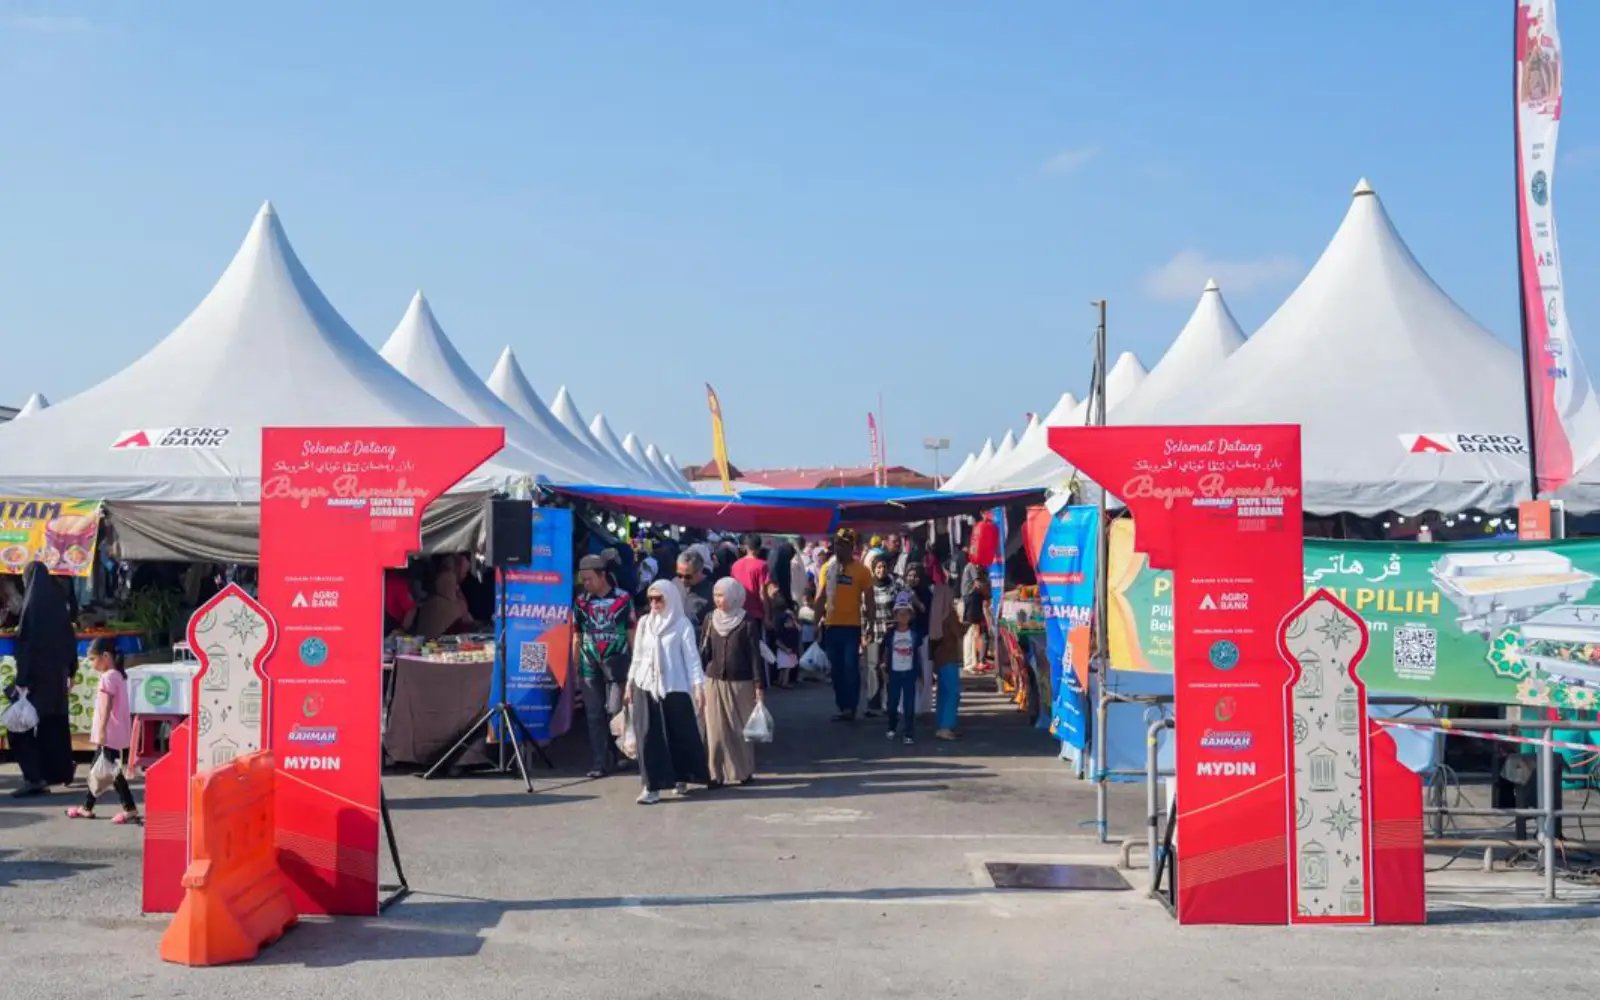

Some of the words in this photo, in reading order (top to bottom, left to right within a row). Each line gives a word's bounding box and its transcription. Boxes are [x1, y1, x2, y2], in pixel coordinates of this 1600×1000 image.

[168, 427, 230, 437] AGRO
[160, 437, 224, 446] BANK
[1456, 433, 1521, 445] AGRO
[302, 439, 349, 456] Selamat
[353, 439, 397, 460] Datang
[1164, 439, 1213, 455] Selamat
[1217, 438, 1262, 458] Datang
[1459, 444, 1528, 454] BANK
[312, 590, 339, 599] AGRO
[1220, 592, 1249, 601] AGRO
[311, 599, 338, 608] BANK
[1220, 601, 1249, 610] BANK
[1356, 587, 1440, 615] PILIH
[288, 731, 336, 741] RAHMAH
[1200, 736, 1250, 746] RAHMAH
[284, 755, 341, 770] MYDIN
[1196, 761, 1256, 776] MYDIN
